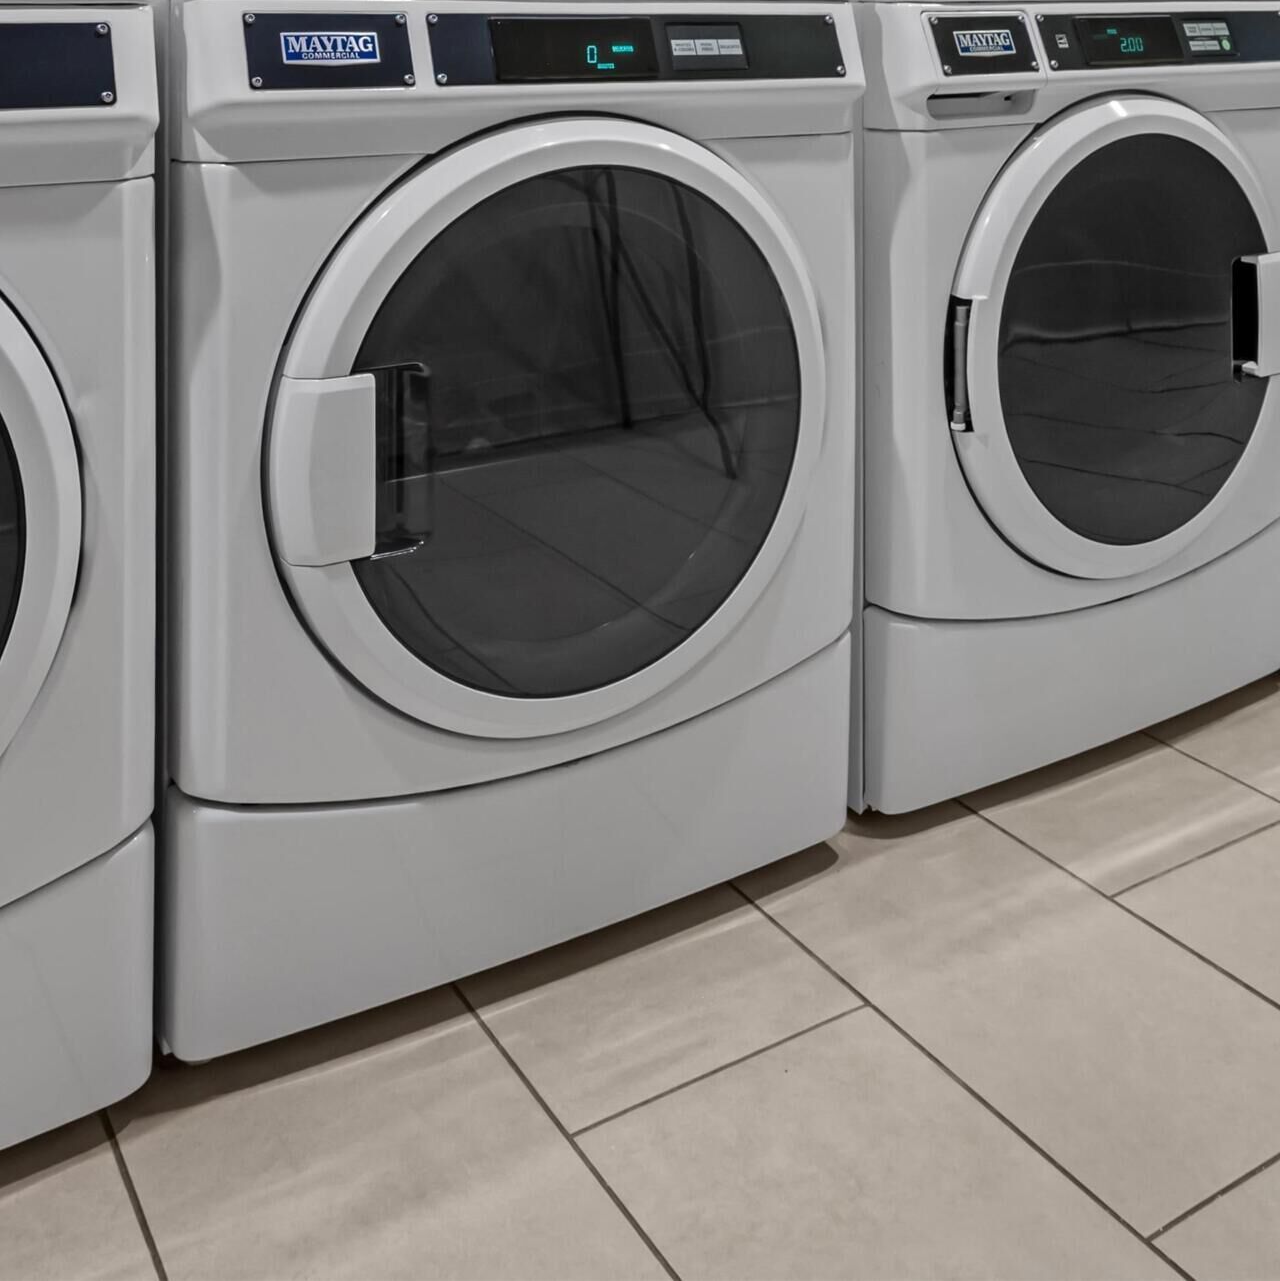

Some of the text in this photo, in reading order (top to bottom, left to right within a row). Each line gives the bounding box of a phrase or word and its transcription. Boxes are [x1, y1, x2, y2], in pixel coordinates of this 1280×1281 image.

[286, 36, 374, 53] MAYTAG
[958, 33, 1011, 47] MAYTAG
[302, 52, 361, 60] COMMERCIAL
